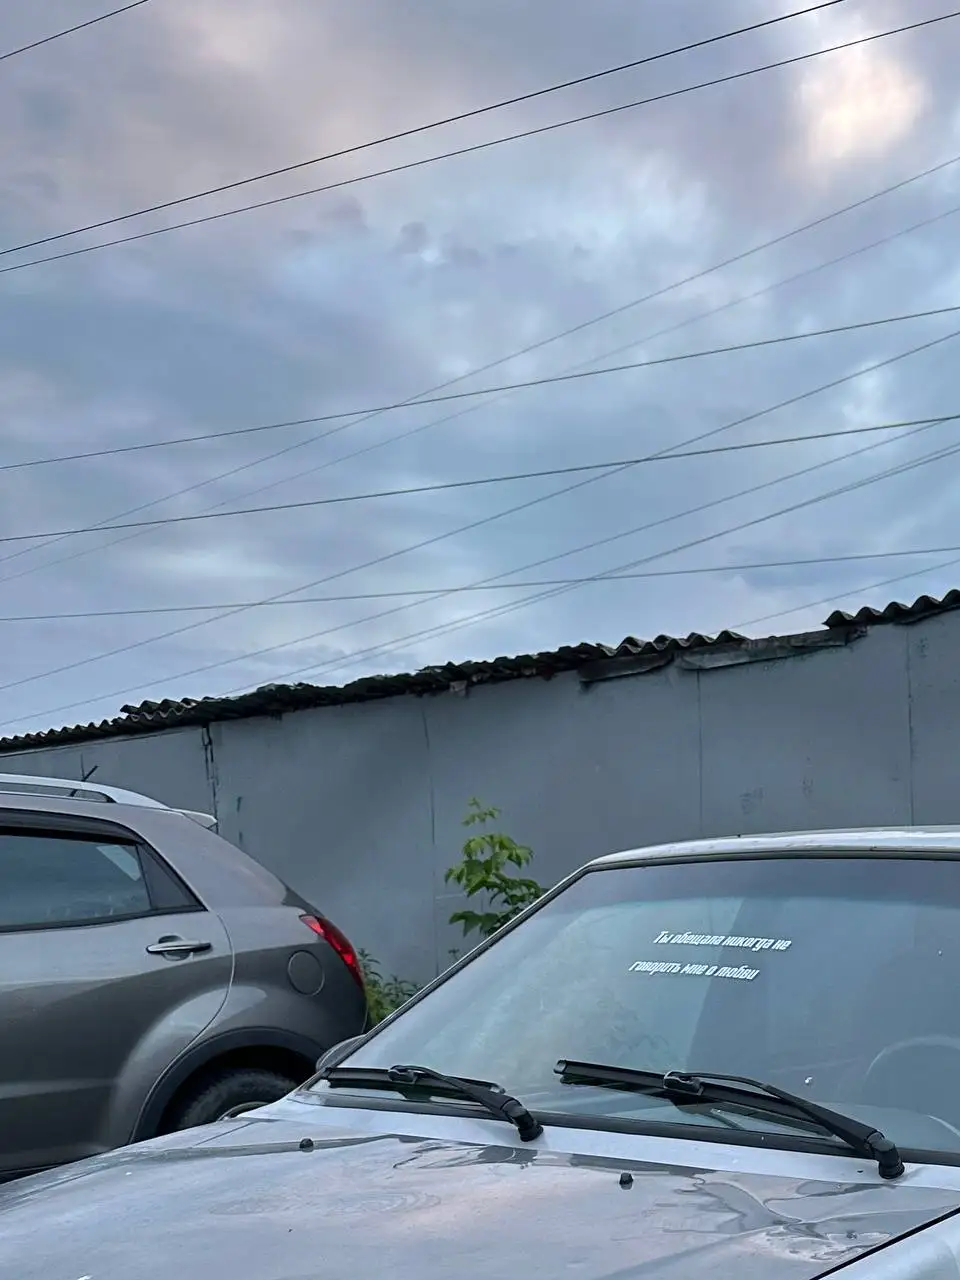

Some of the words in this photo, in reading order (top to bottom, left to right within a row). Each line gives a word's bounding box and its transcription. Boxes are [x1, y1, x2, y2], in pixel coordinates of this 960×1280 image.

[653, 931, 674, 943] Ты
[670, 932, 725, 945] обещала
[722, 936, 774, 951] никогда
[772, 940, 791, 950] не
[629, 961, 681, 975] говорить
[680, 964, 708, 975] мне
[705, 965, 718, 975] о
[714, 965, 760, 980] любви
